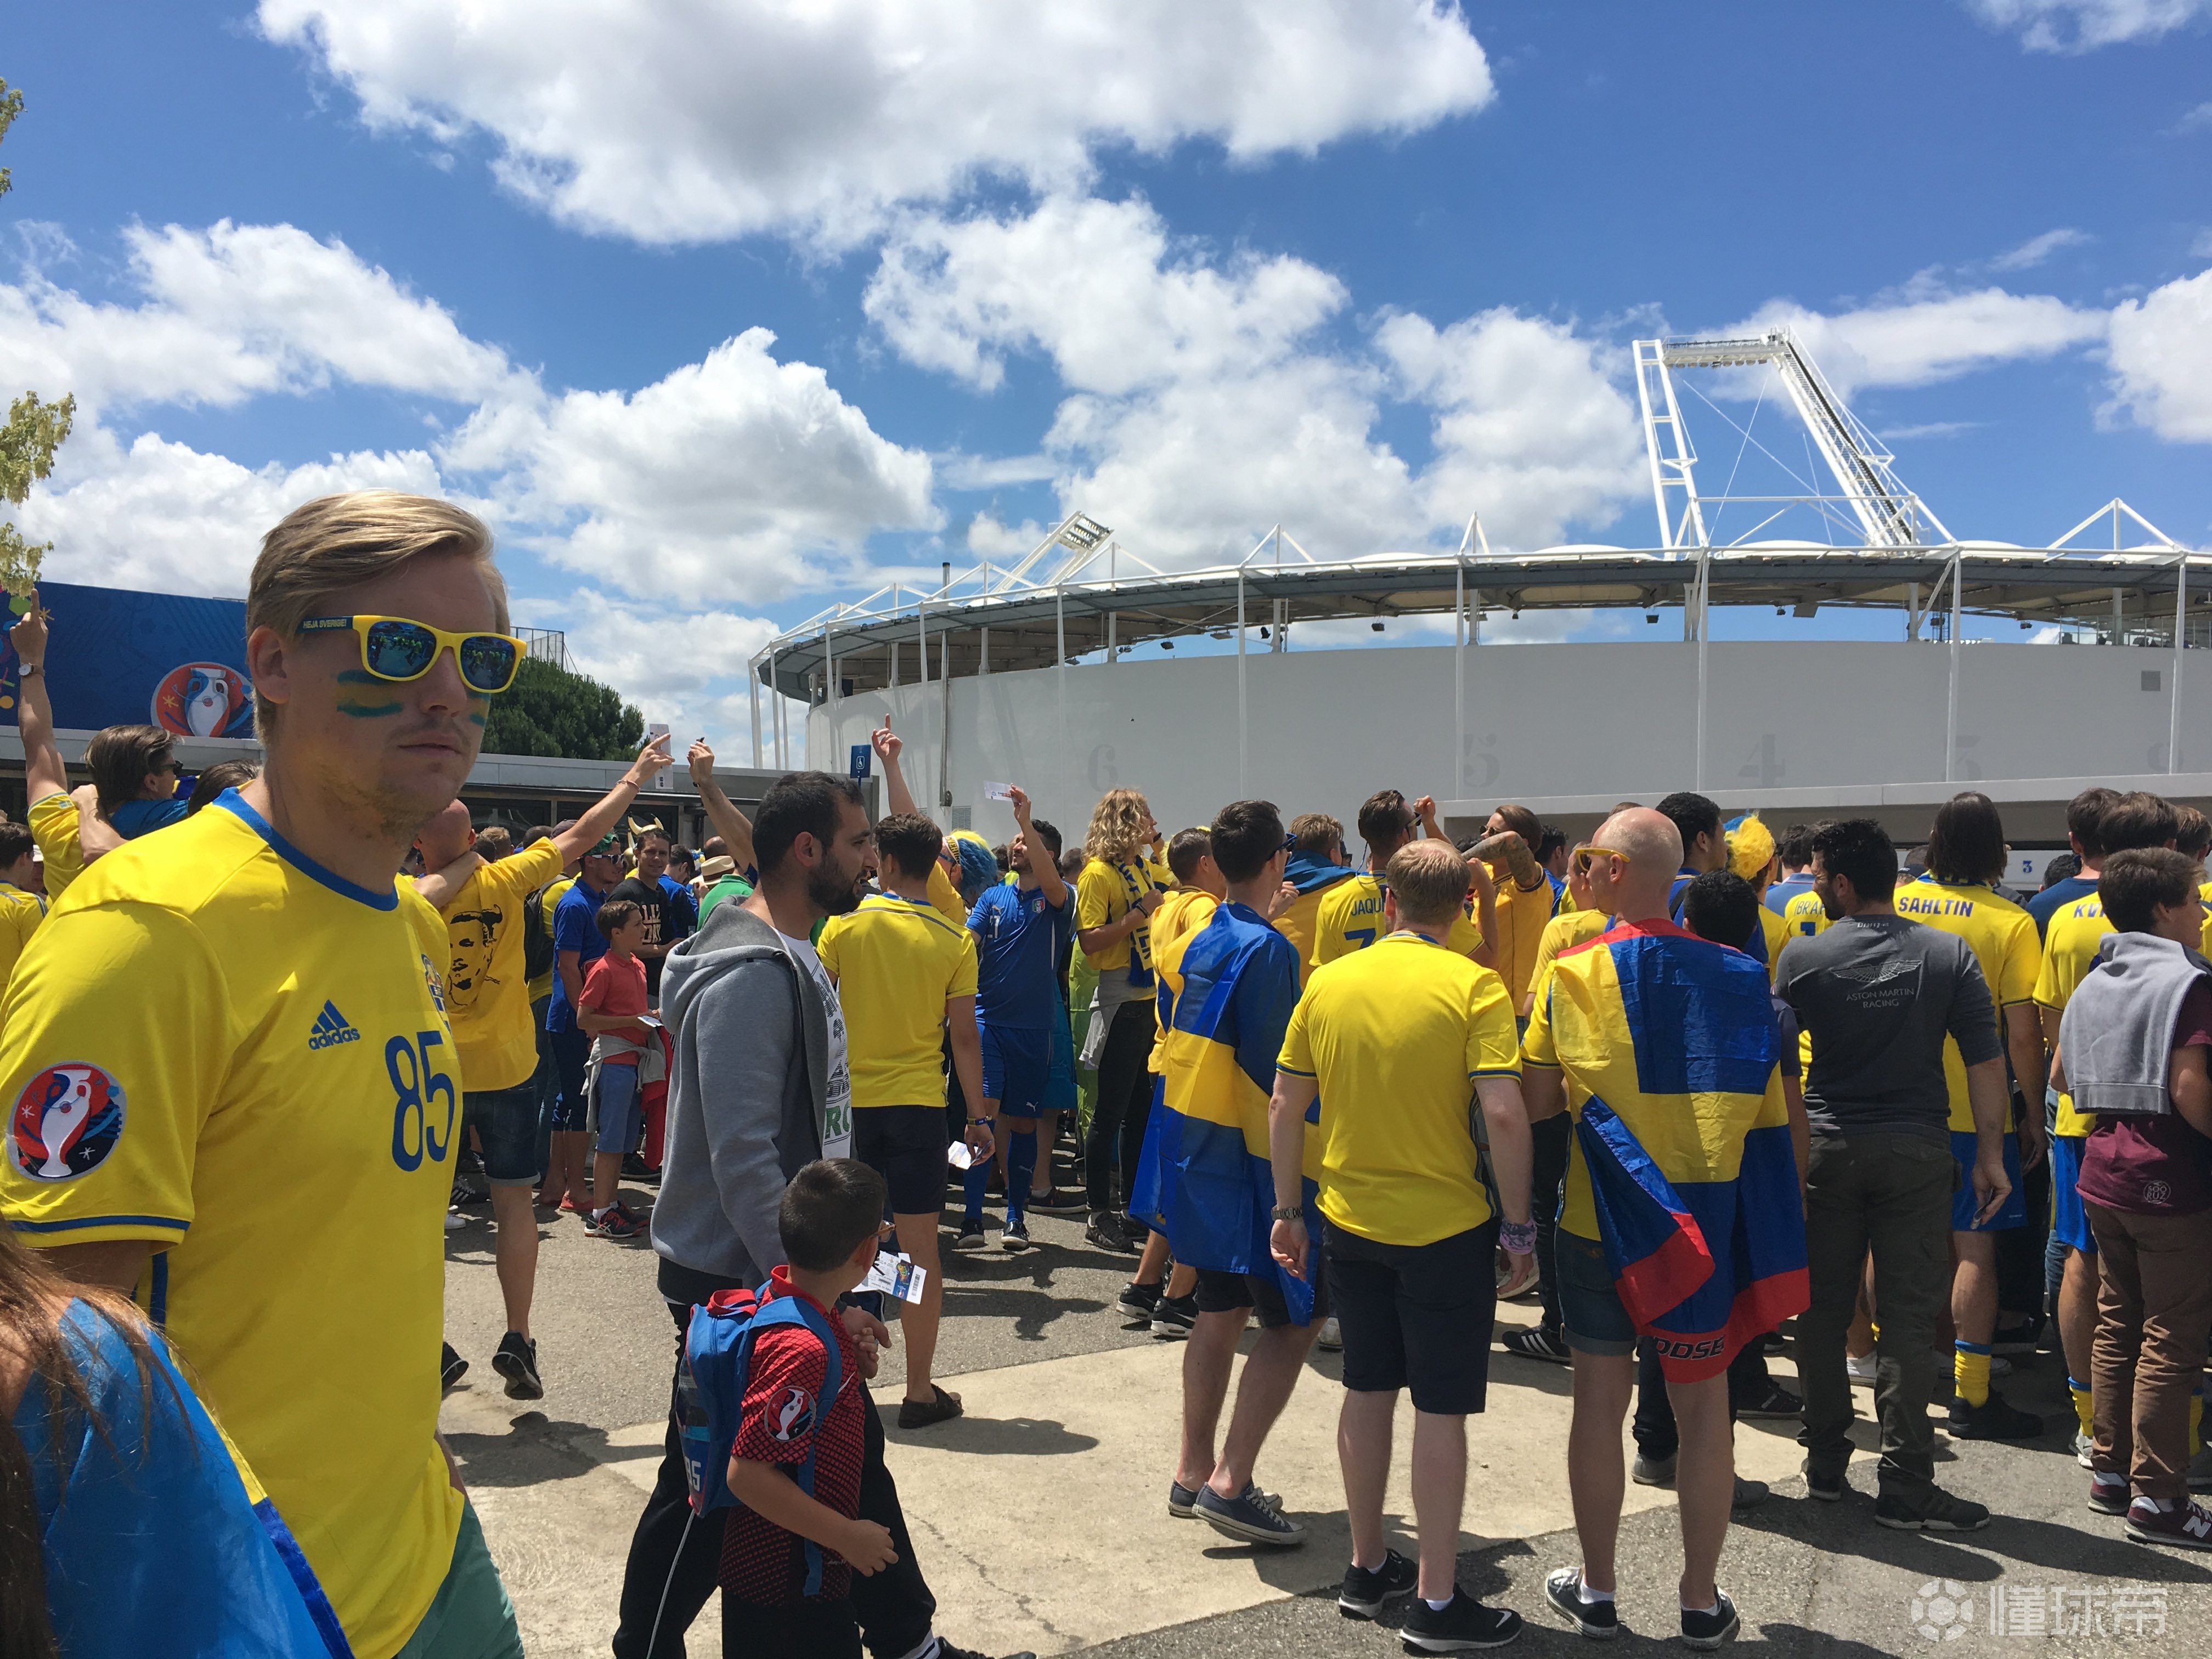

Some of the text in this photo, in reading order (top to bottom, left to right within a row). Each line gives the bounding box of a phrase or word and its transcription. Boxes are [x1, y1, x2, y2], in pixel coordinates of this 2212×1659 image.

[303, 620, 318, 629] HEJA
[1087, 744, 1119, 792] 6
[1463, 733, 1500, 788] 5
[1738, 734, 1786, 788] 4
[2023, 860, 2032, 873] 3
[1351, 898, 1385, 916] JAQU
[1898, 896, 1974, 918] SAHLTIN
[1846, 988, 1915, 1001] ASTON MARTIN
[1863, 998, 1899, 1008] RACING
[308, 1028, 360, 1050] adidas
[385, 1030, 455, 1172] 85
